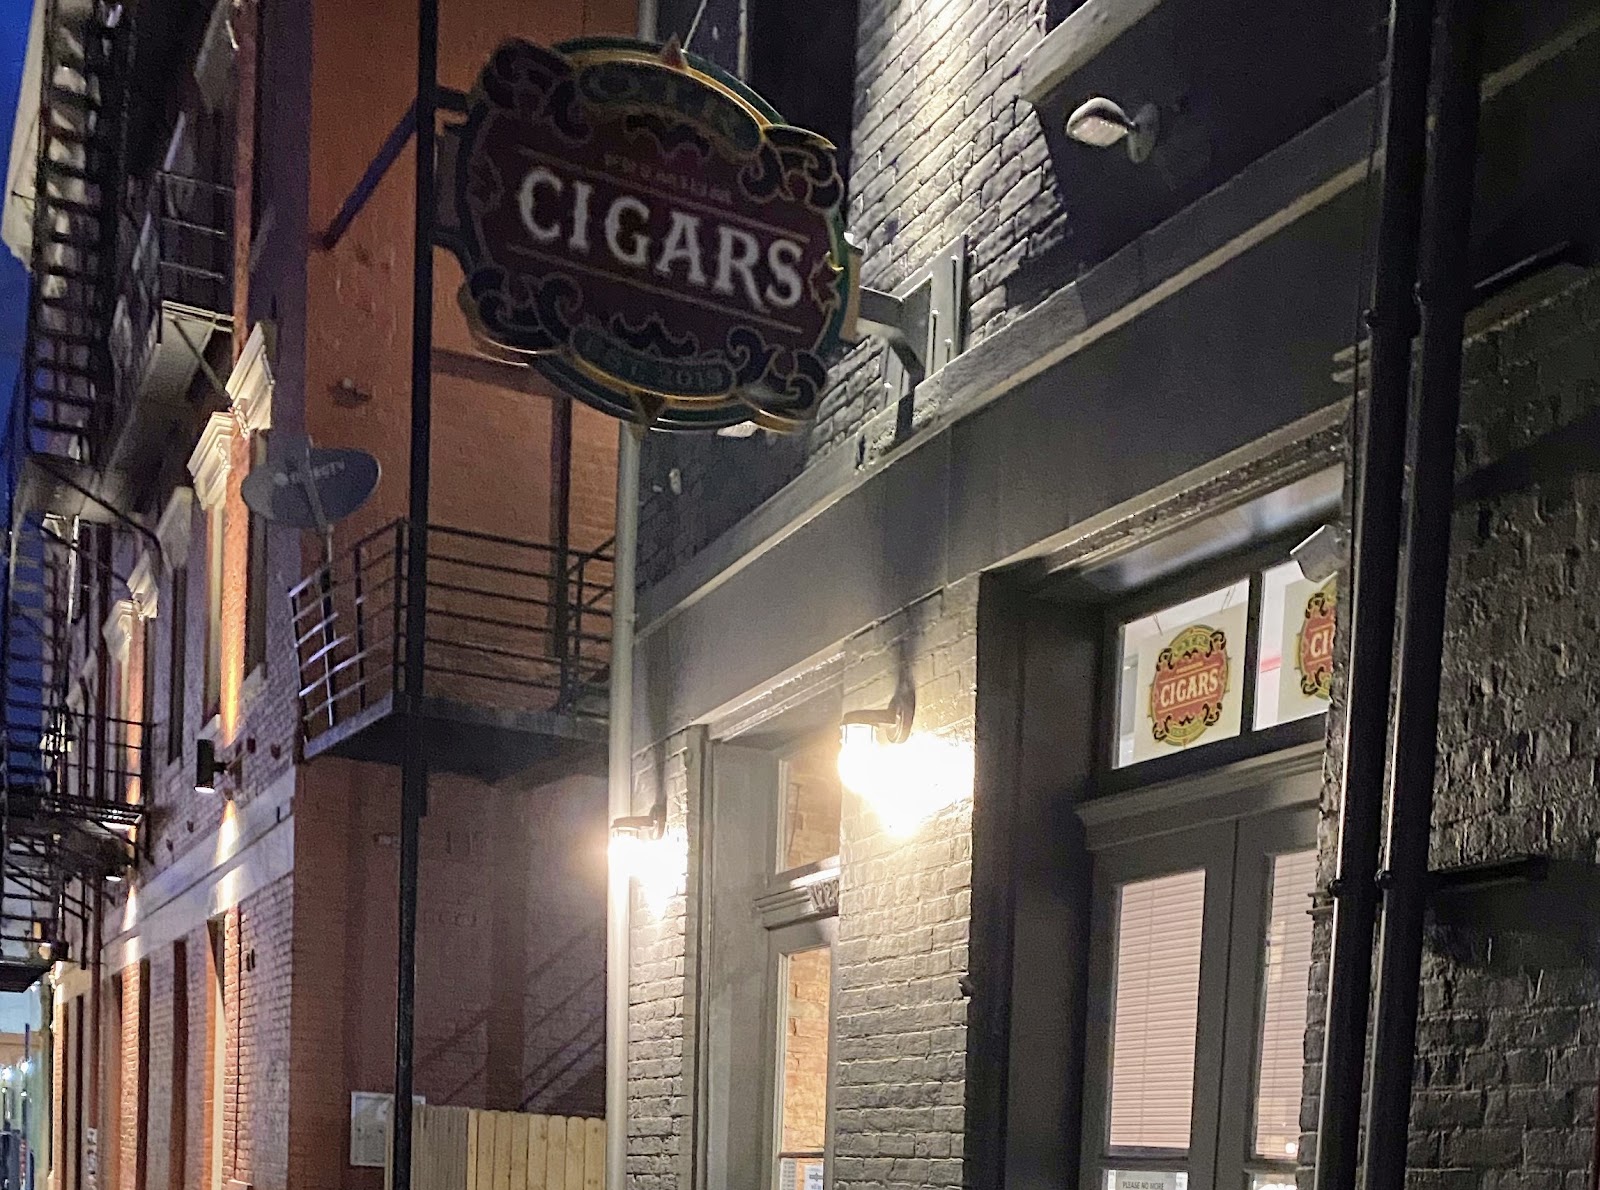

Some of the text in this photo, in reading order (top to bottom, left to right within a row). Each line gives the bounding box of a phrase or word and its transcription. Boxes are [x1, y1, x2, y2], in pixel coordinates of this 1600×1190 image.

[518, 165, 804, 315] CIGARS
[1160, 668, 1219, 708] CIGARS
[1122, 1181, 1164, 1190] PLEASE NO MORE
